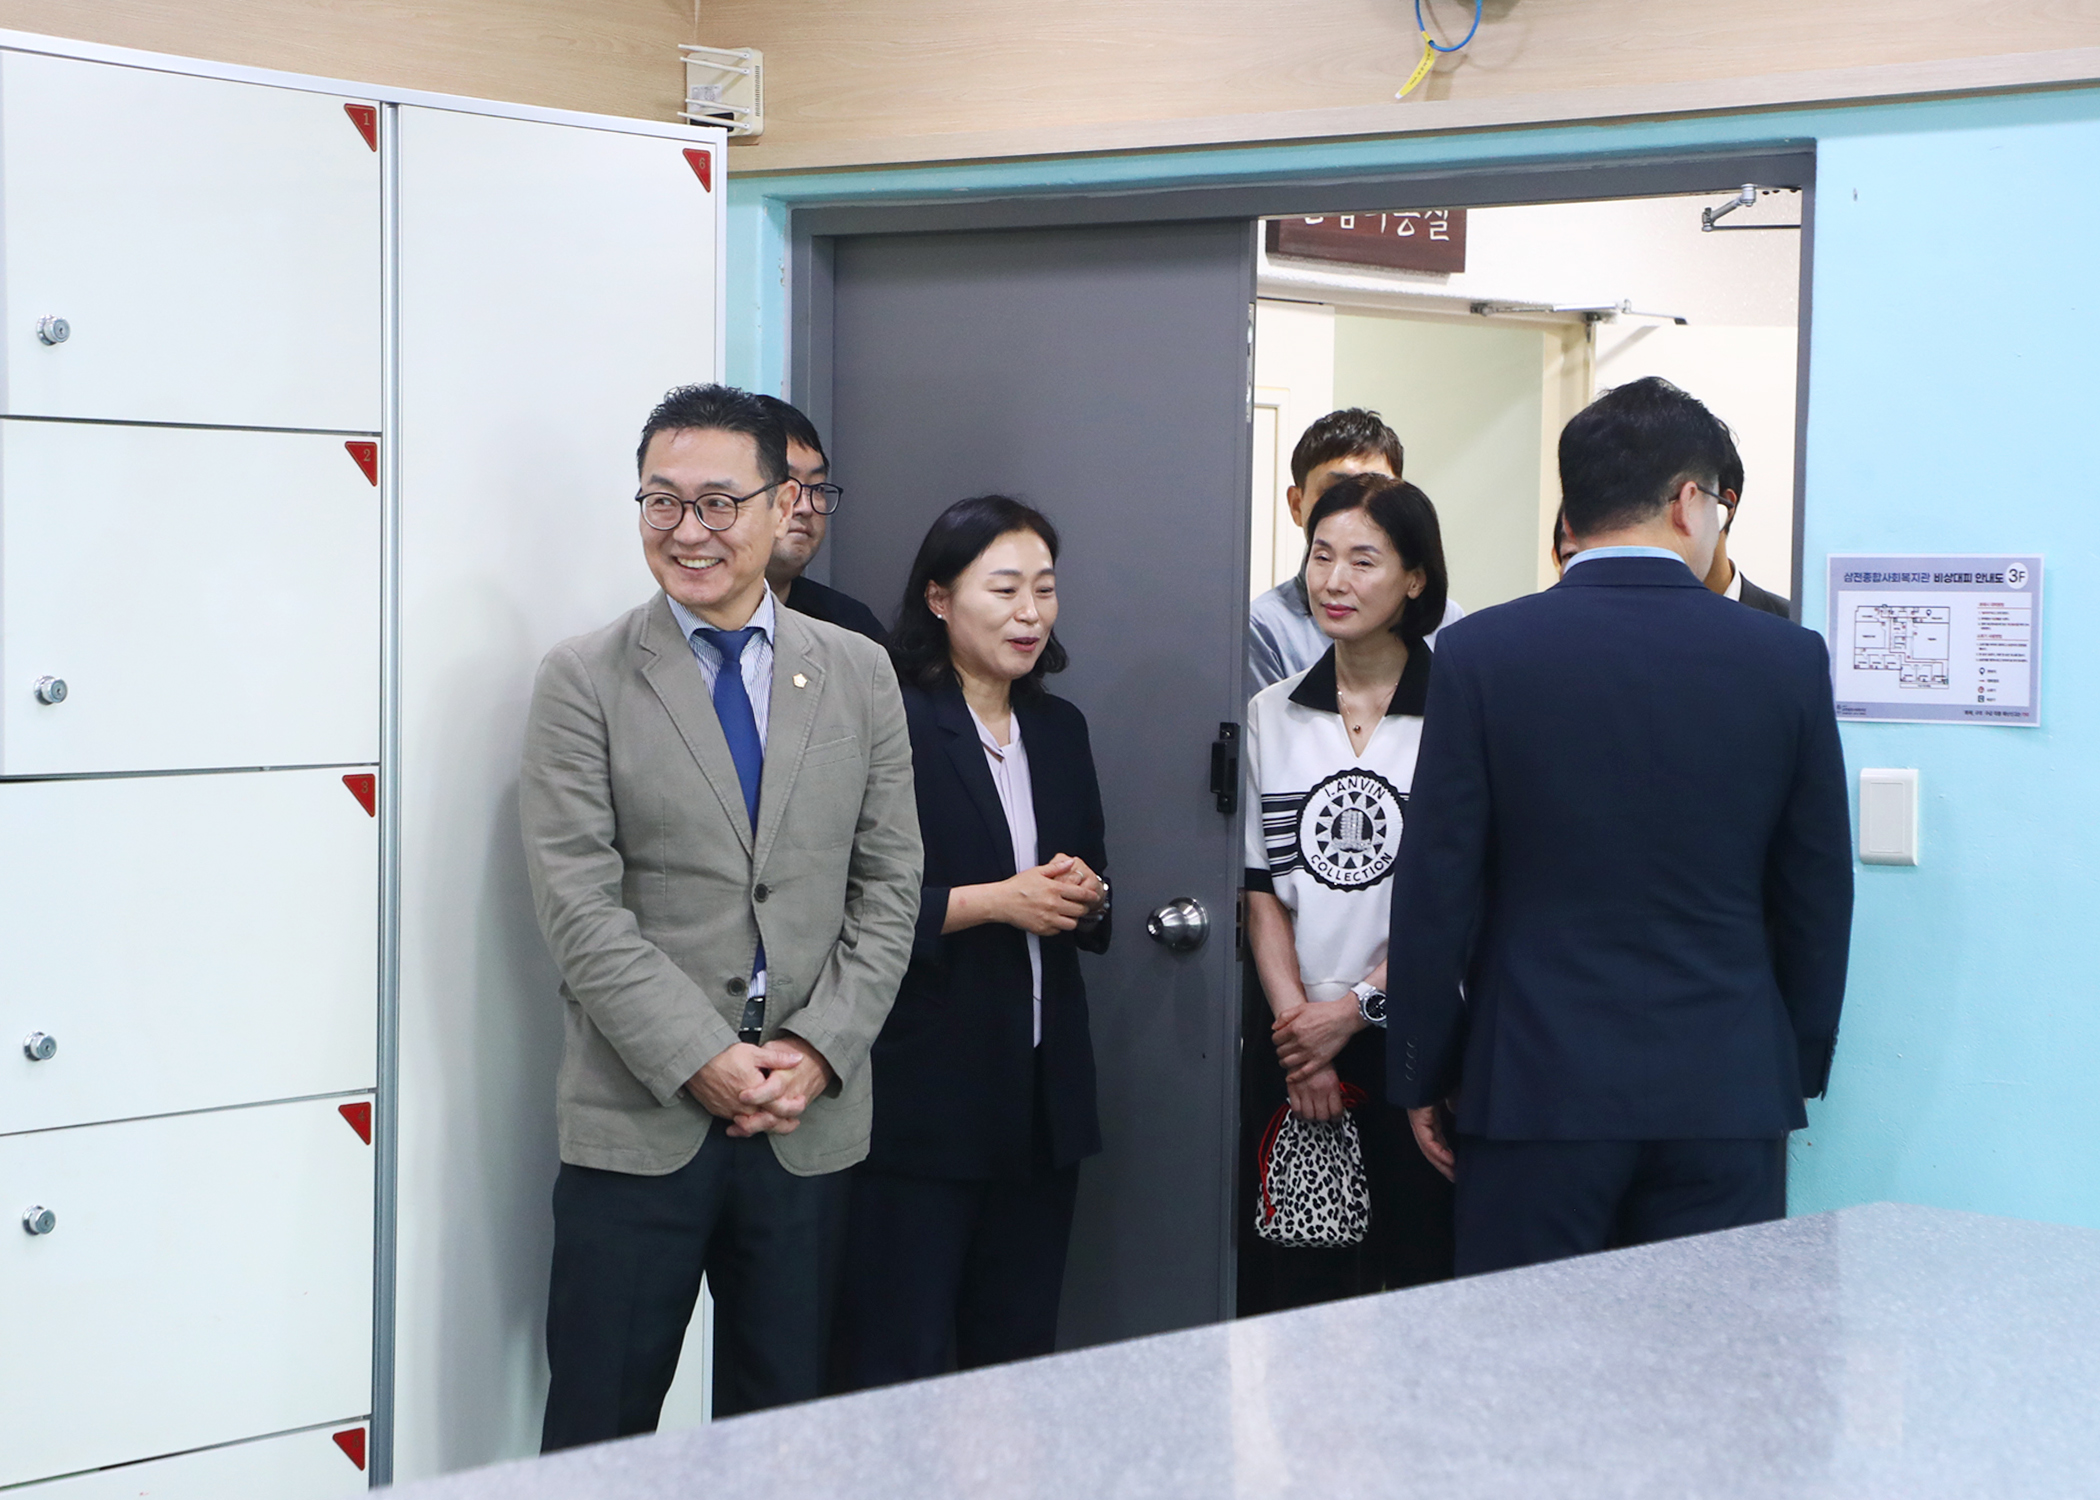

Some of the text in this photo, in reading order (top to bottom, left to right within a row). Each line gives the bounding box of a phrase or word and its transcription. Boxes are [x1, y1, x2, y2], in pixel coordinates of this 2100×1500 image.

[364, 113, 370, 125] 1
[699, 157, 706, 169] 6
[364, 449, 371, 462] 2
[1844, 568, 2026, 583] 삼전종합사회복지관 비상대피 안내도 3F
[362, 782, 369, 794] 3
[1325, 778, 1387, 800] LANVIN
[1310, 852, 1393, 882] COLLECTION
[358, 1111, 366, 1122] 4
